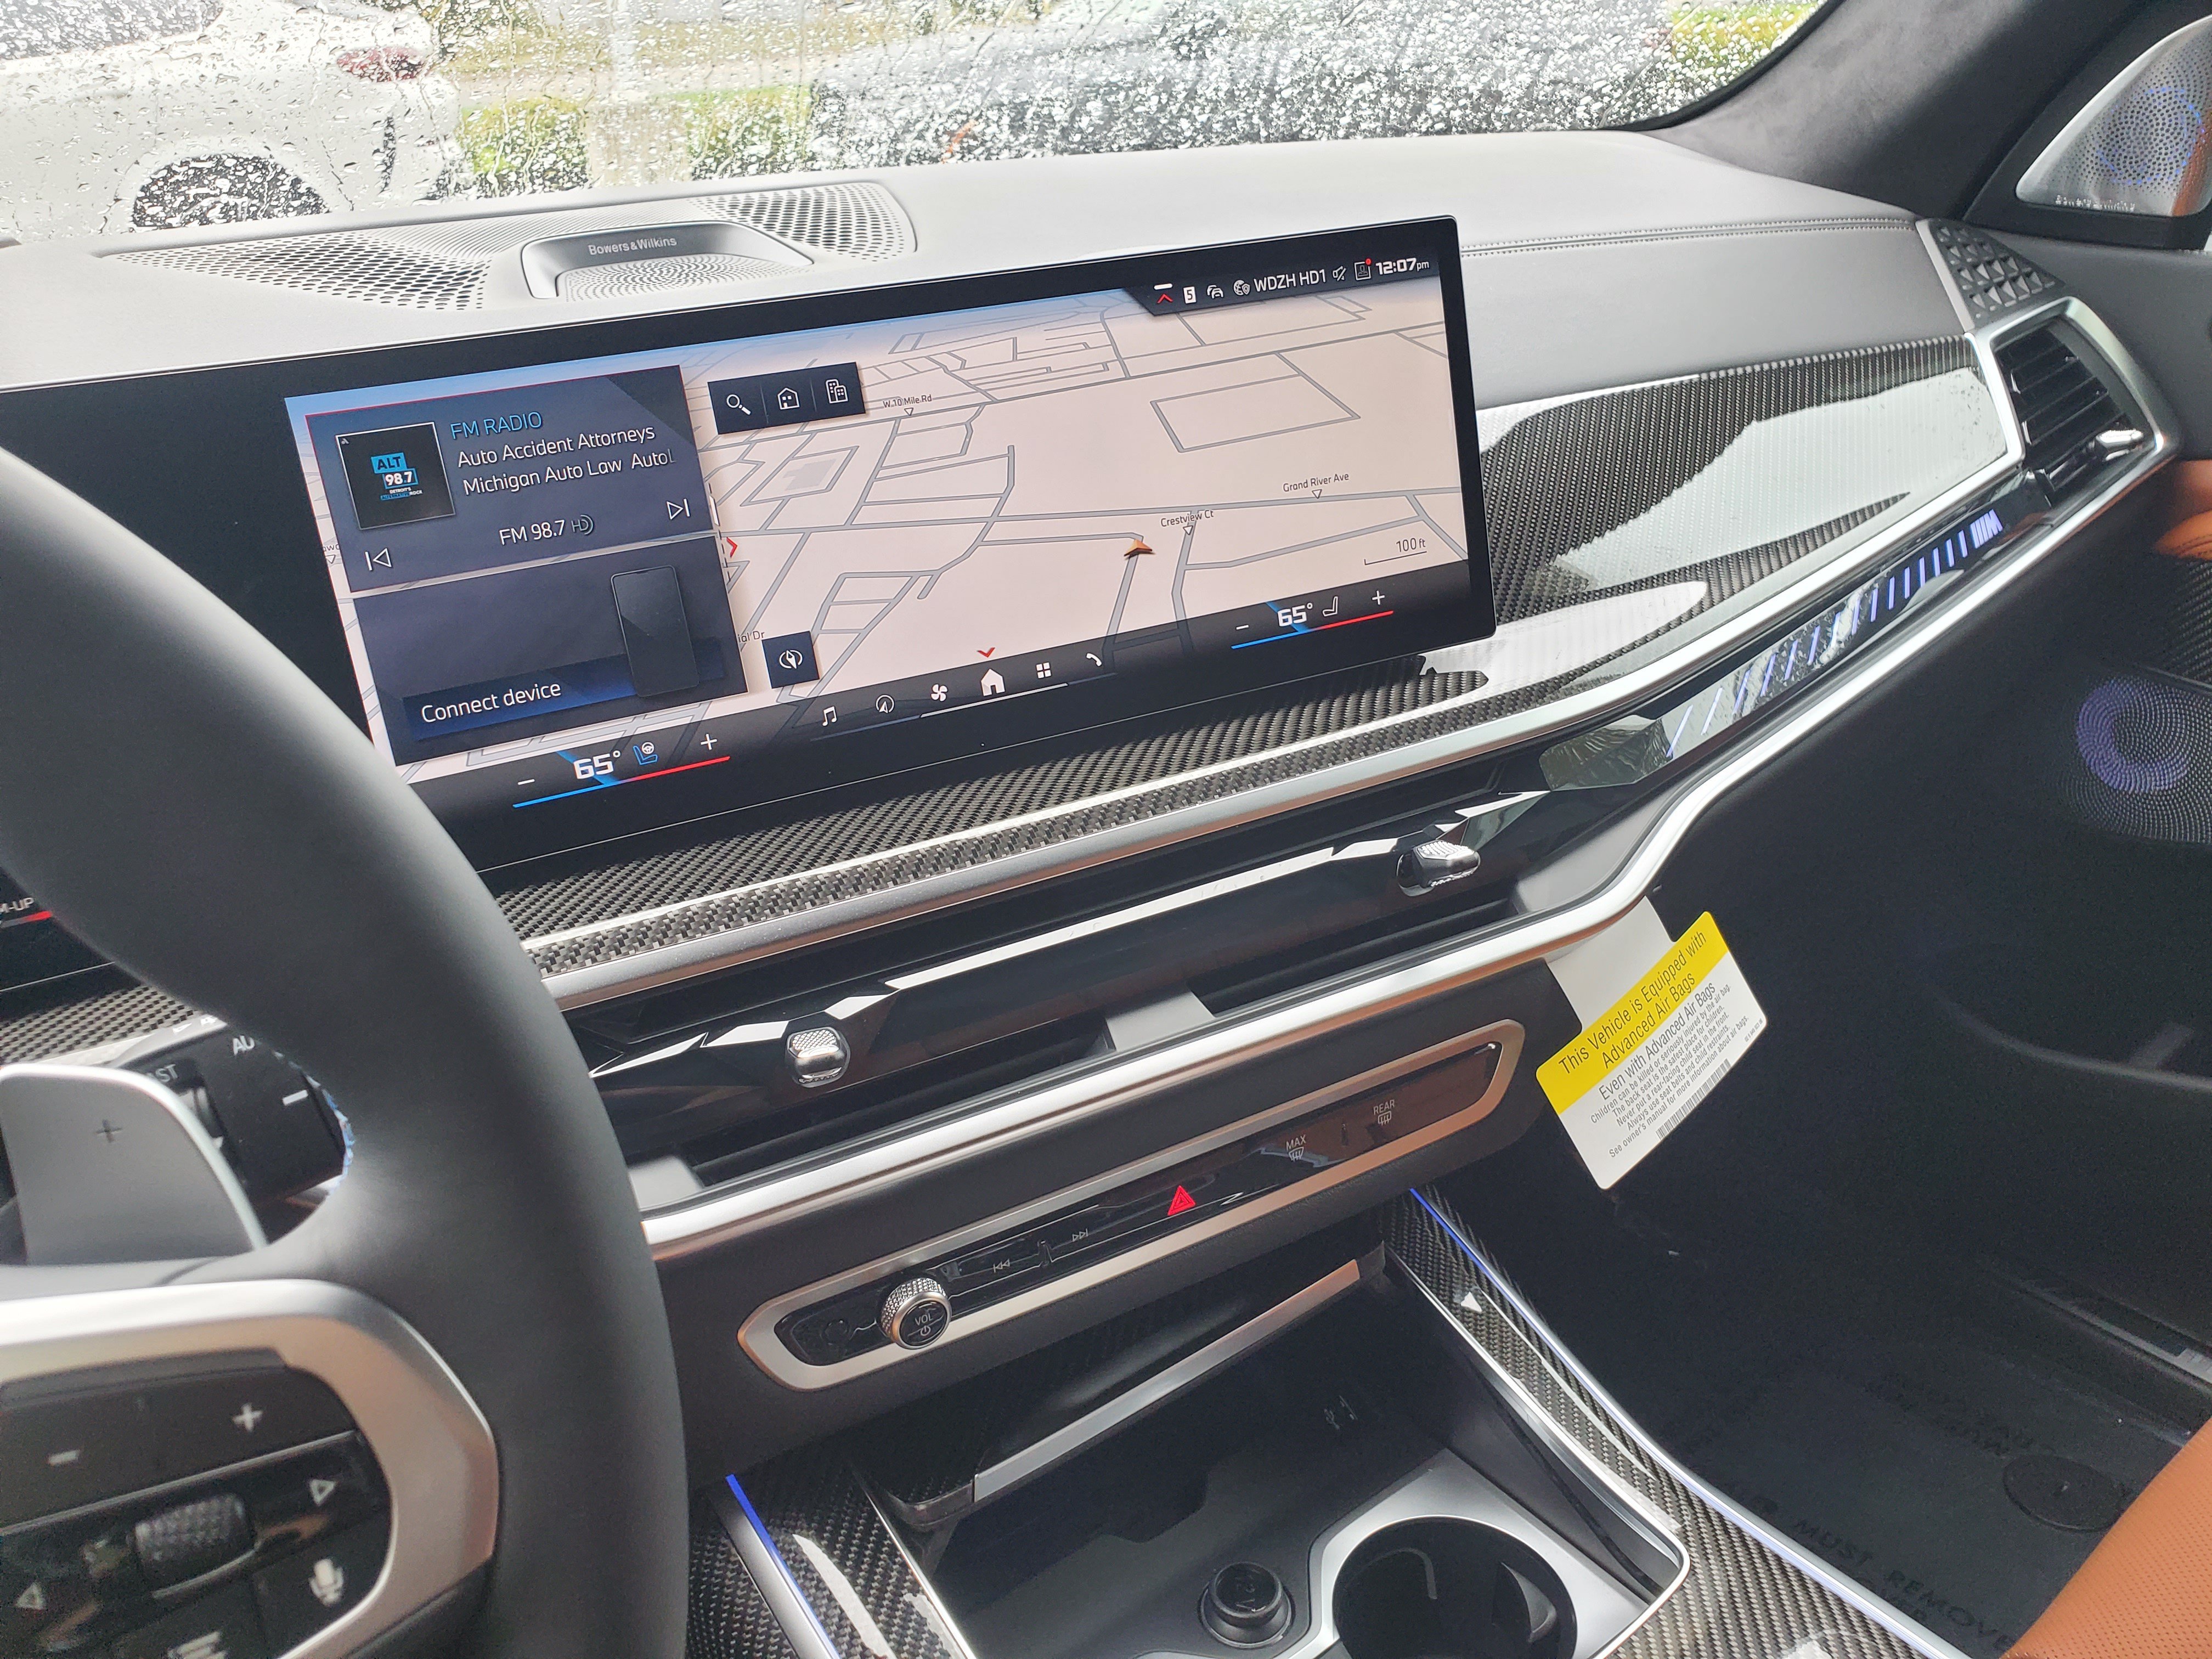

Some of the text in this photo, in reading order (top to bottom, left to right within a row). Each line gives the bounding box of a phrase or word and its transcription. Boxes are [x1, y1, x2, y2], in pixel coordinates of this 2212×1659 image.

[1254, 269, 1327, 292] WDZH HD1
[904, 397, 919, 405] Mile
[922, 394, 932, 403] Rd
[450, 411, 543, 439] FM RADIO
[458, 426, 656, 468] Auto Accident Attorneys
[377, 456, 401, 470] ALT
[385, 471, 412, 486] 98.7
[462, 471, 540, 495] Michigan
[545, 464, 583, 483] Auto
[587, 459, 622, 476] Law
[1283, 472, 1349, 493] Grand River Ave
[1160, 509, 1214, 528] Crestview Ct
[499, 526, 528, 545] FM
[531, 520, 565, 540] 98.7
[1396, 538, 1426, 553] 100 ft
[753, 630, 765, 640] Dr
[421, 682, 562, 724] Connect device
[1558, 931, 1707, 1074] This Vehicle is Equipped with
[1602, 973, 1695, 1069] Advanced Air Bags
[1599, 983, 1716, 1101] Even with Advanced Air Bags
[1590, 1098, 1618, 1124] Children
[1618, 1088, 1630, 1101] can
[1628, 1080, 1639, 1091] be
[1637, 1063, 1654, 1084] killed
[1654, 1058, 1661, 1068] or
[1660, 1034, 1687, 1062] seriously
[1682, 1015, 1701, 1038] injured
[1700, 1010, 1707, 1020] by
[1706, 1001, 1715, 1013] the
[1611, 1005, 1725, 1118] The back seat is the safest place for children.
[1616, 1107, 1635, 1127] Never
[1635, 1097, 1647, 1113] put
[1651, 1064, 1681, 1097] rear-facing
[1679, 1049, 1693, 1068] child
[1692, 1039, 1704, 1054] seat
[1701, 1034, 1709, 1043] in
[1707, 1025, 1716, 1037] the
[1715, 1011, 1729, 1028] front.
[1609, 1144, 1622, 1158] See
[1622, 1123, 1646, 1147] owner's
[1646, 1101, 1668, 1125] manual
[1666, 1093, 1676, 1105] for
[1676, 1080, 1691, 1097] more
[1689, 1050, 1718, 1083] information
[1717, 1034, 1731, 1053] about
[1627, 1108, 1649, 1131] Always
[1648, 1098, 1660, 1111] use
[1659, 1085, 1673, 1101] seat
[1670, 1071, 1685, 1089] belts
[1684, 1060, 1696, 1075] and
[1695, 1047, 1708, 1065] child
[1373, 1099, 1395, 1115] REAR
[1286, 1135, 1306, 1150] MAX
[915, 1313, 934, 1326] VOL
